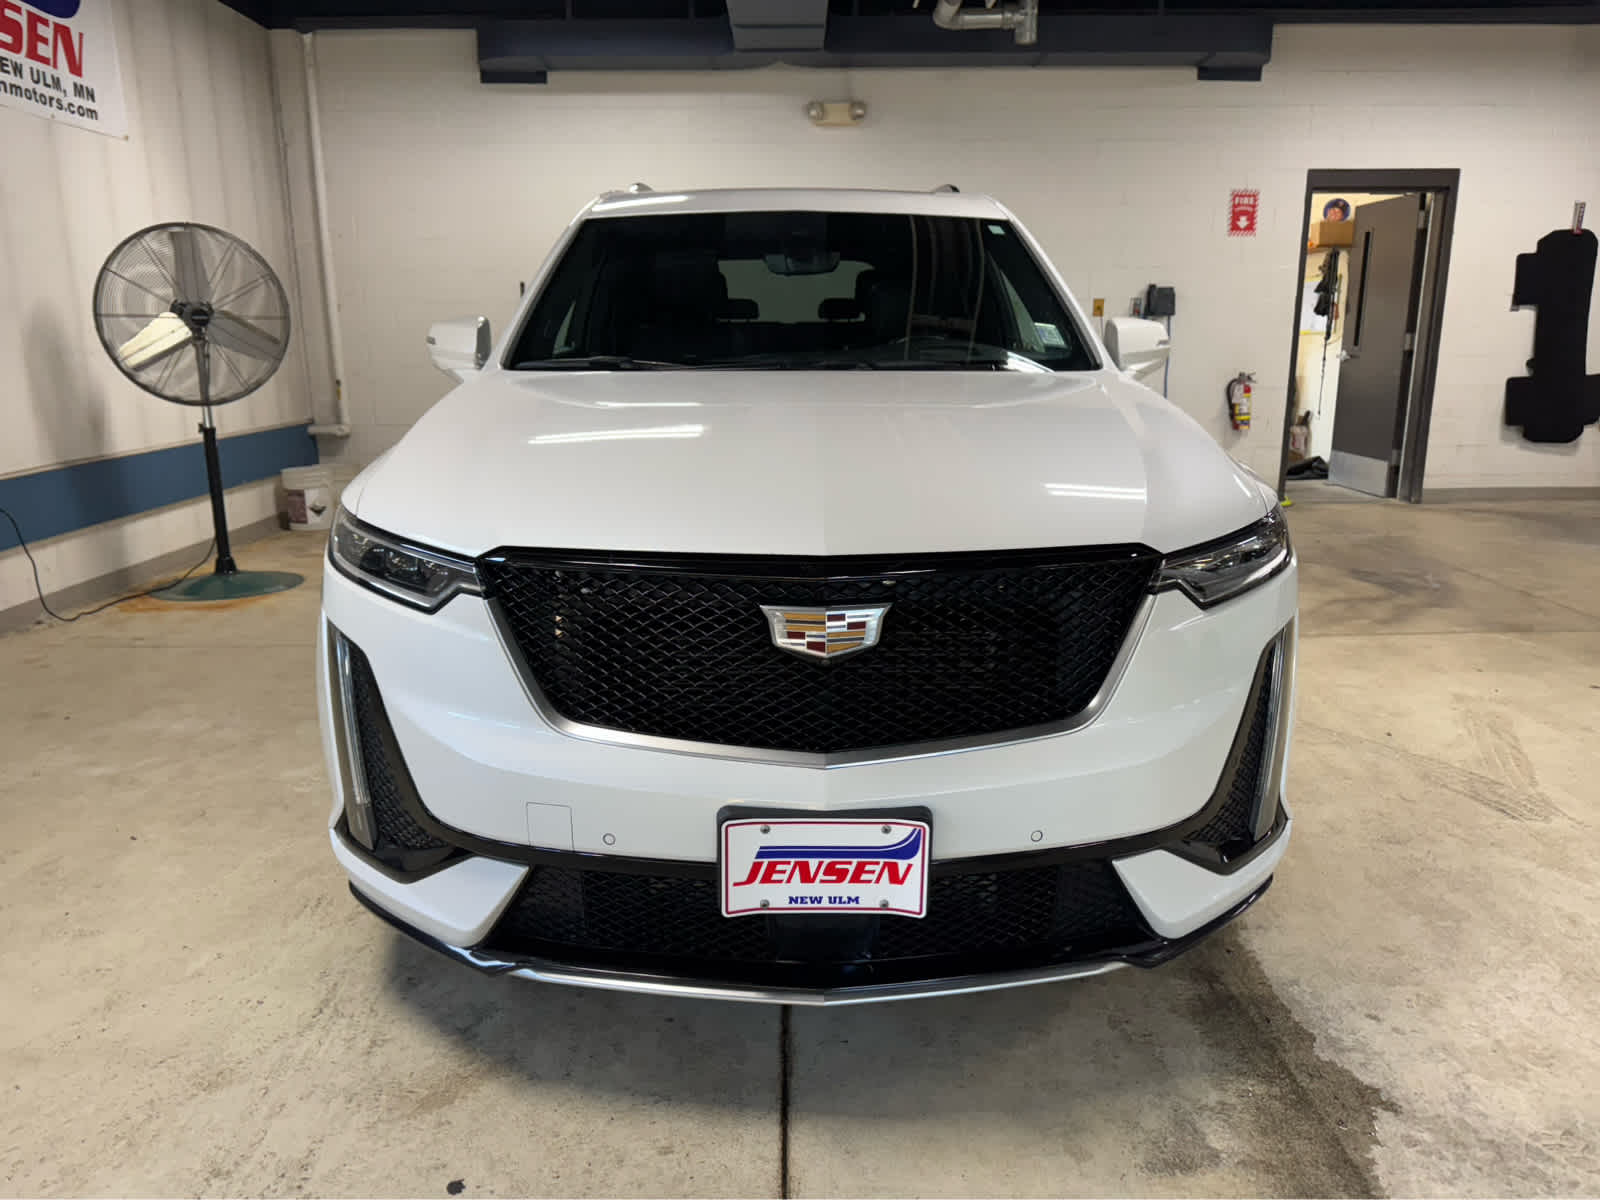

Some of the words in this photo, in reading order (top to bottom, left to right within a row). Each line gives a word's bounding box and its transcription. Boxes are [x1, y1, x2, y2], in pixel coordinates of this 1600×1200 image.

[0, 0, 84, 78] SEN
[29, 66, 67, 97] ULM,
[72, 81, 96, 103] MN
[732, 861, 913, 887] JENSEN
[788, 896, 823, 904] NEW
[828, 896, 860, 904] ULM
